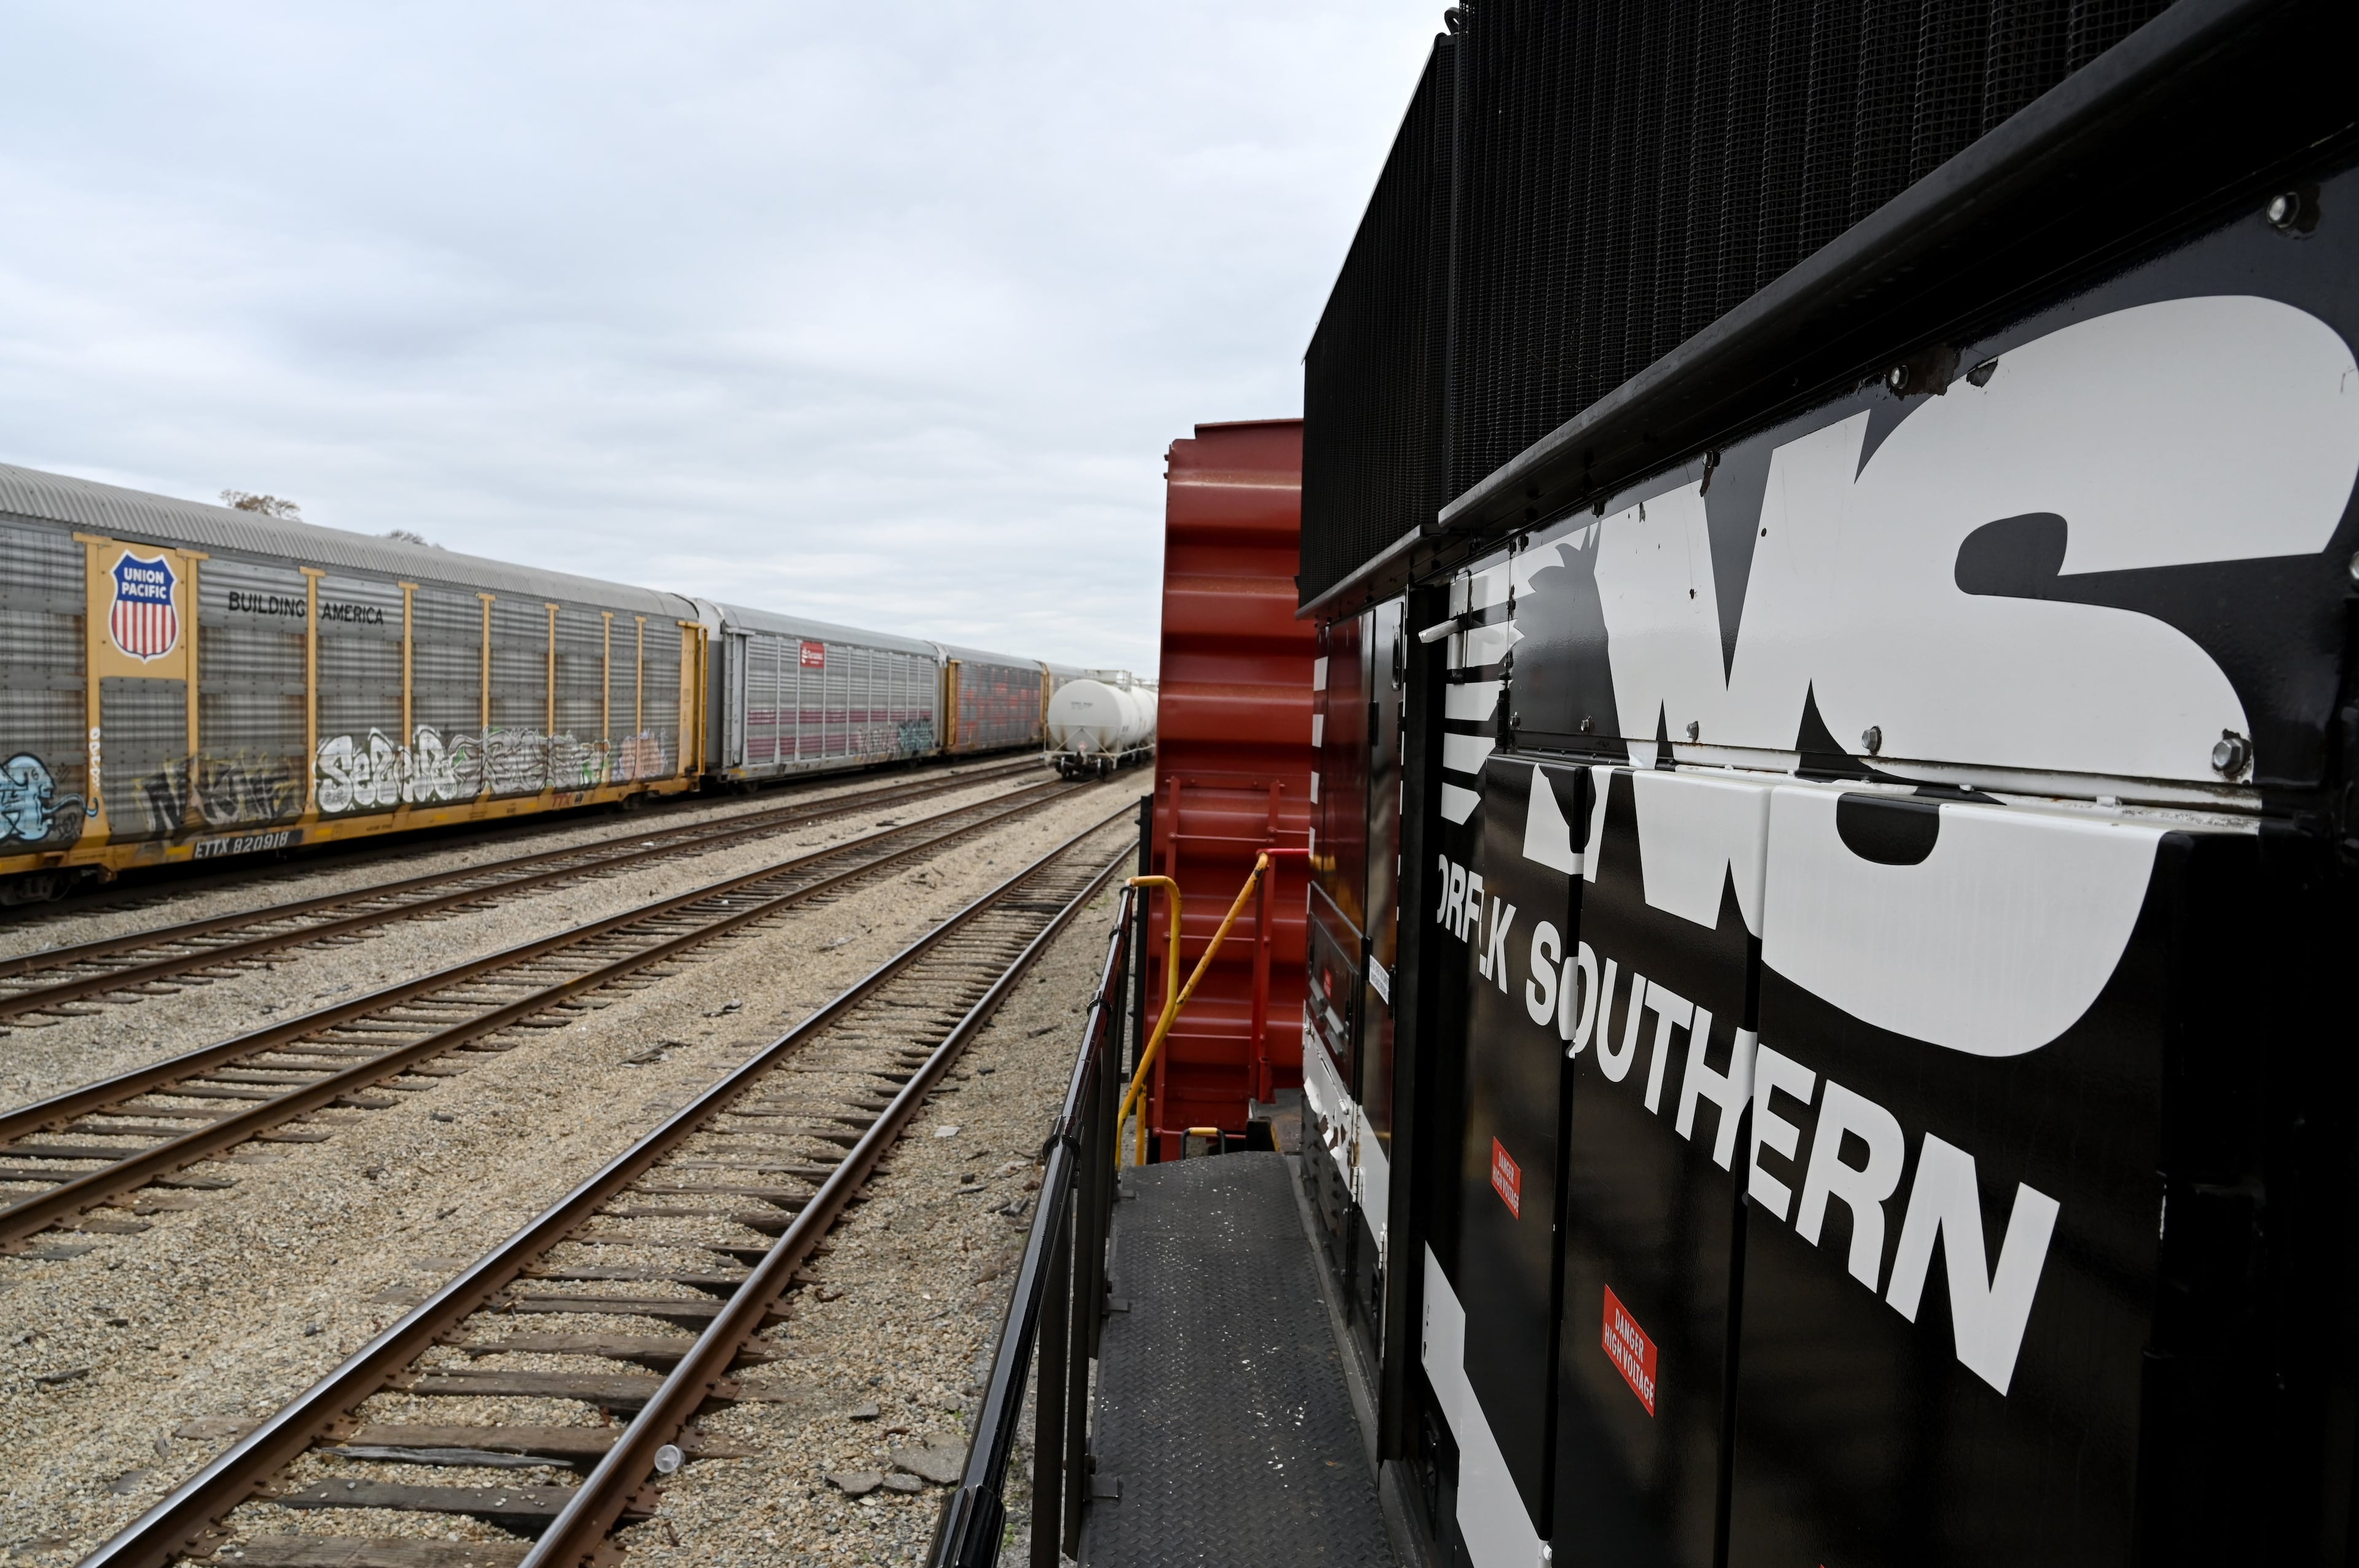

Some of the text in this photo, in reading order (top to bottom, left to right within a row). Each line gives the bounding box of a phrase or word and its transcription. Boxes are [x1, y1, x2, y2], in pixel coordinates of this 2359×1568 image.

[122, 582, 166, 599] PACIFIC
[124, 567, 164, 584] UNION
[229, 591, 384, 625] BUILDING AMERICA
[195, 831, 290, 859] ETTX 820918
[1499, 1150, 1514, 1185] DANGER
[1525, 921, 2060, 1397] SOUTHERN
[1493, 1164, 1519, 1214] HIGH VOLTAGE
[1615, 1308, 1644, 1363] DANGER
[1605, 1322, 1654, 1406] HIGH VOLTAGE
